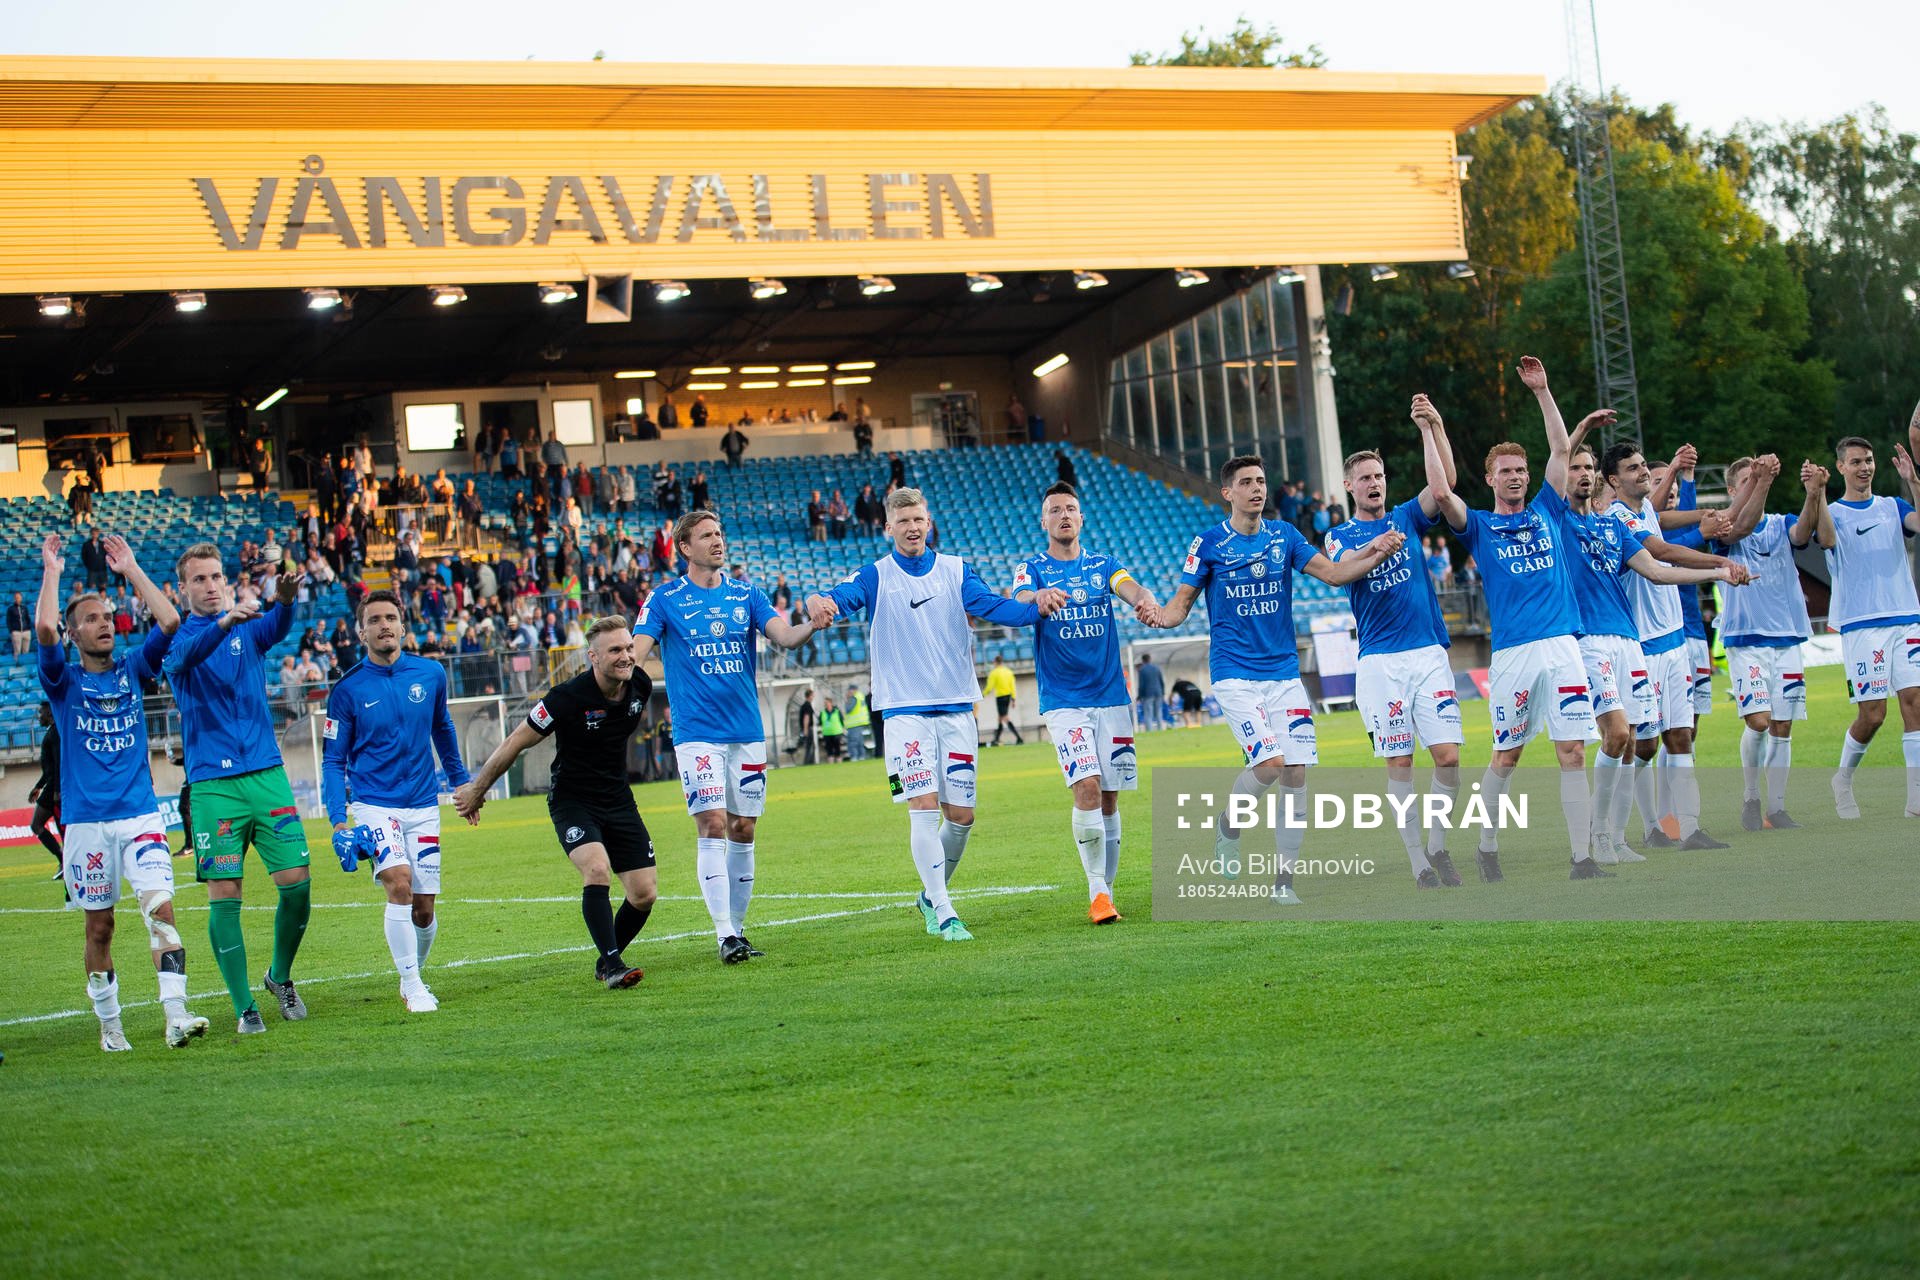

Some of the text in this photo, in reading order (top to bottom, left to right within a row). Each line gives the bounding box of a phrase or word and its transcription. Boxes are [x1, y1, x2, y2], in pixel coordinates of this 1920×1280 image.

[191, 154, 997, 251] VÅNGAVALLEN
[1366, 547, 1411, 579] ELLBY
[1369, 567, 1412, 593] GÅRD
[1236, 598, 1279, 617] GÅRD
[1060, 621, 1104, 640] GÅRD
[701, 658, 744, 675] GÅRD
[1495, 706, 1505, 722] 15
[1241, 720, 1255, 738] 19
[1389, 718, 1405, 727] KFX
[86, 734, 135, 752] GÅRD
[1387, 733, 1411, 743] INTER
[1058, 742, 1070, 760] 14
[1072, 744, 1088, 753] KFX
[221, 759, 233, 769] M
[906, 758, 924, 768] KFX
[682, 770, 690, 786] 9
[696, 772, 714, 781] KFX
[905, 770, 932, 784] INTER
[907, 778, 932, 791] SPORT
[698, 786, 724, 797] INTER
[699, 794, 725, 805] SPORT
[196, 832, 211, 850] 32
[71, 864, 83, 882] 10
[86, 872, 105, 881] KFX
[87, 892, 113, 903] SPOR
